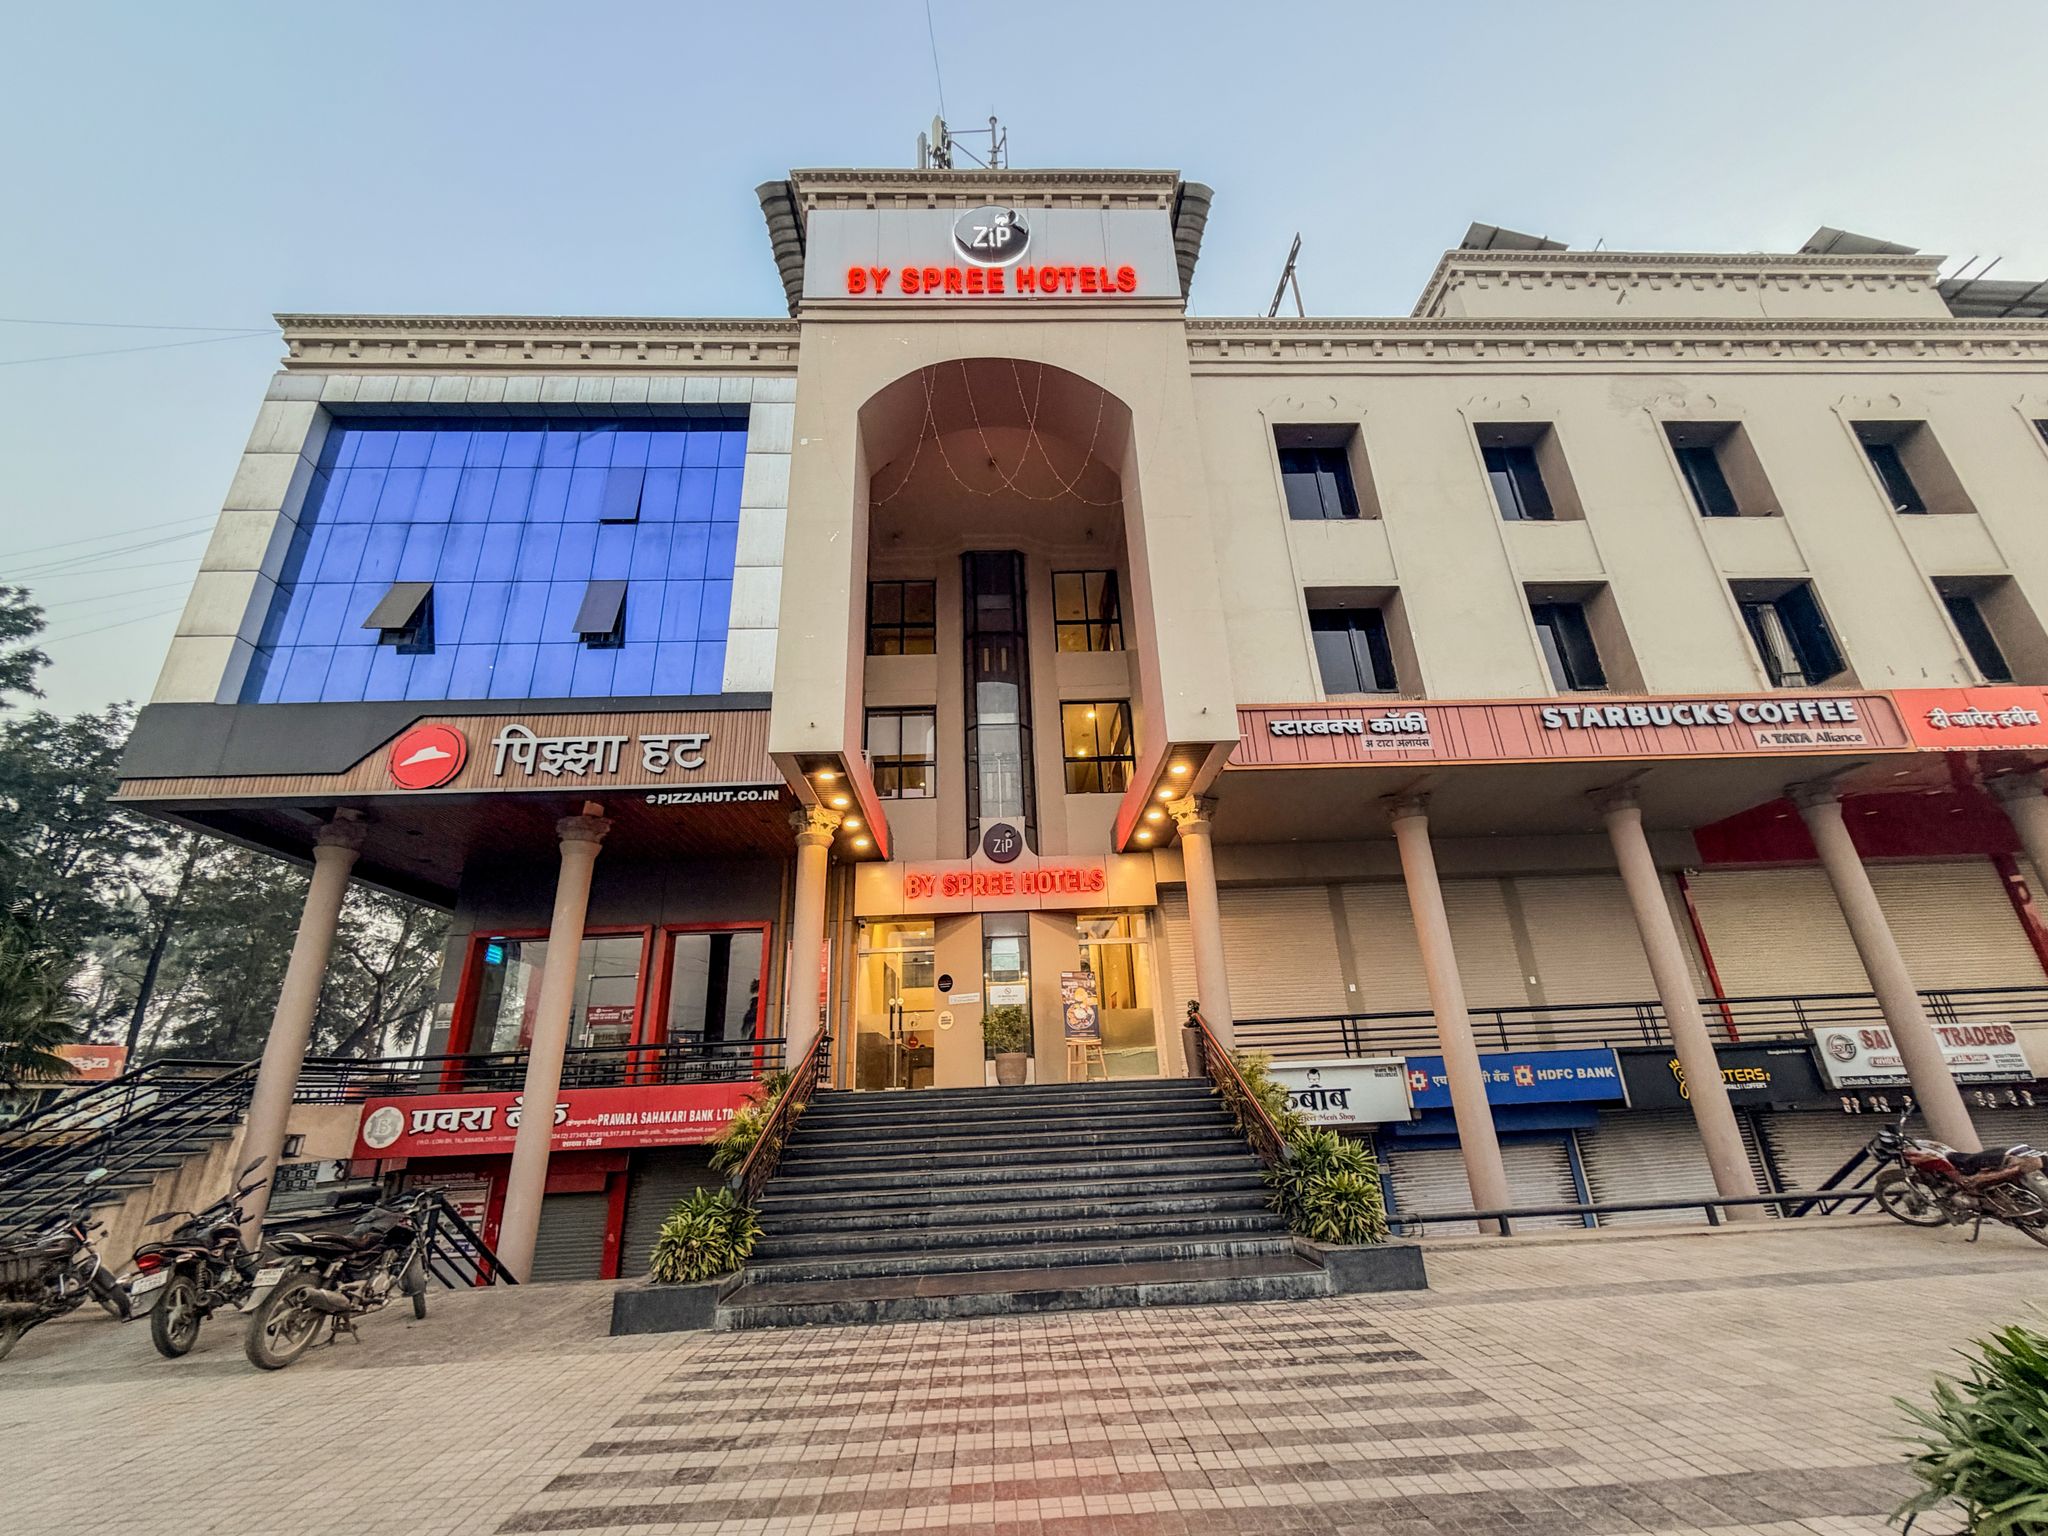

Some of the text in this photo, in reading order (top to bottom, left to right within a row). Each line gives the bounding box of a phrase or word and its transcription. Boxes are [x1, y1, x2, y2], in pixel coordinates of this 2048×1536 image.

[973, 226, 1011, 247] ZiP
[848, 266, 1137, 294] BY SPREE HOTELS
[1270, 711, 1428, 736] स्टारबक्स कॉफी
[1541, 700, 1859, 729] STARBUCKS COFFEE
[1759, 731, 1863, 744] A TATA Alliance
[639, 733, 710, 775] हट
[906, 869, 1105, 898] BY SPREE HOTELS
[1860, 1025, 2016, 1050] SAI TRADERS
[1537, 1066, 1616, 1081] HDFC BANK
[409, 1106, 497, 1135] प्रवरा
[597, 1112, 638, 1127] PRAVARA
[640, 1109, 687, 1125] SAHAKARI
[690, 1108, 713, 1123] BANK
